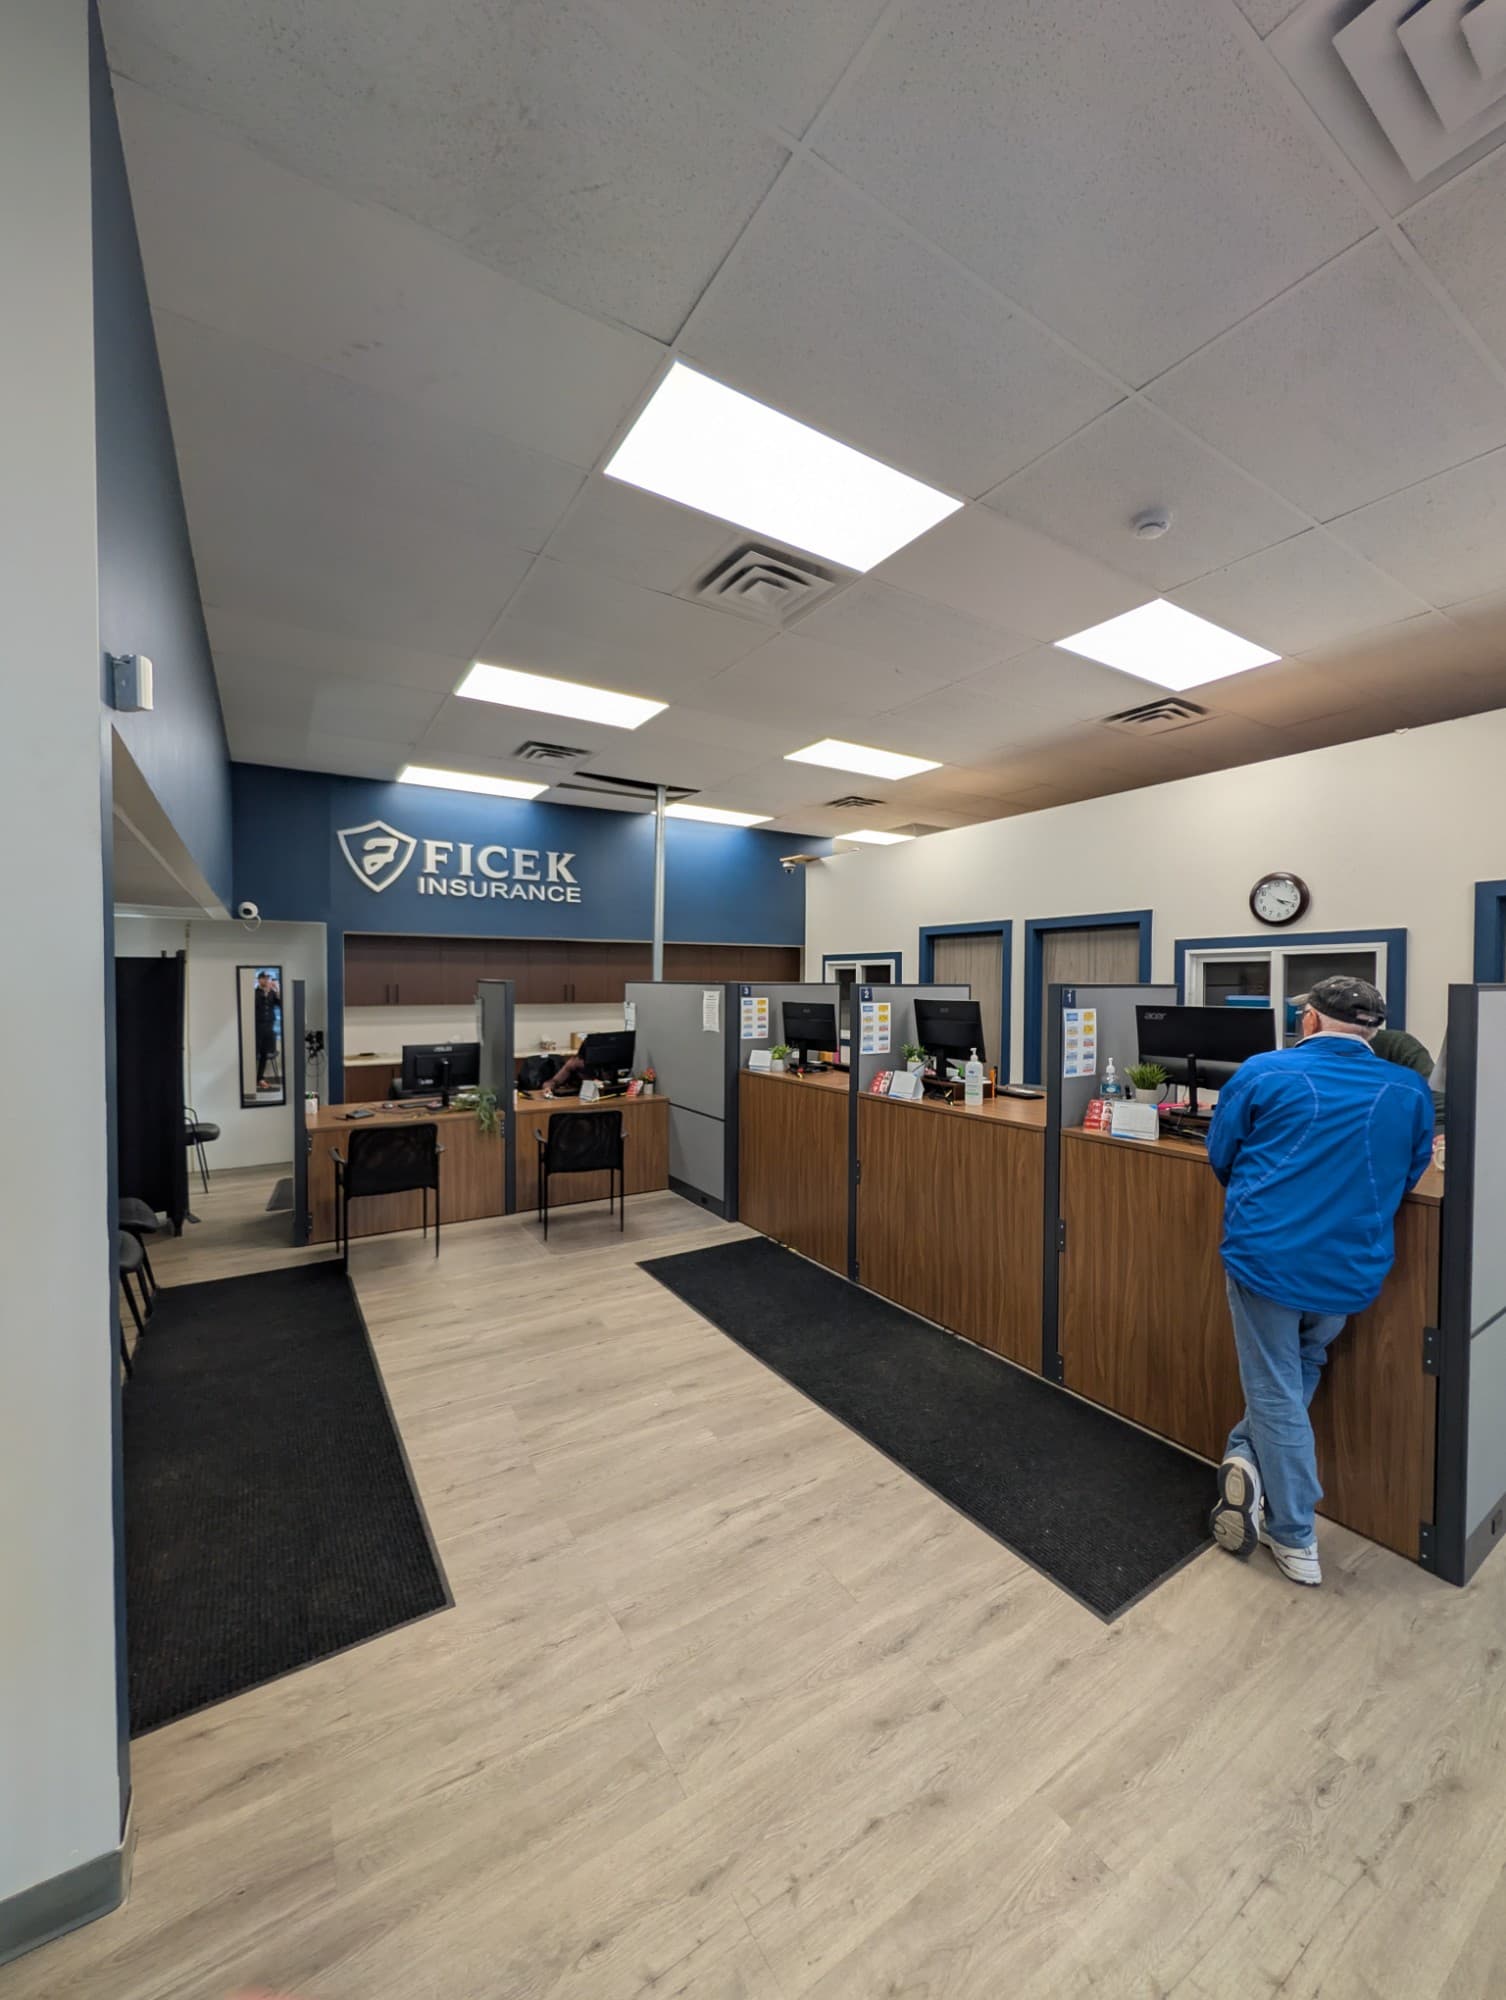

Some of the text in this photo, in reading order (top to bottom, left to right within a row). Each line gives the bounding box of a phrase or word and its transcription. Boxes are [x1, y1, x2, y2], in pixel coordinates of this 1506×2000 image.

[421, 838, 579, 884] FICEK
[416, 875, 582, 904] INSURANCE
[864, 990, 870, 999] 2
